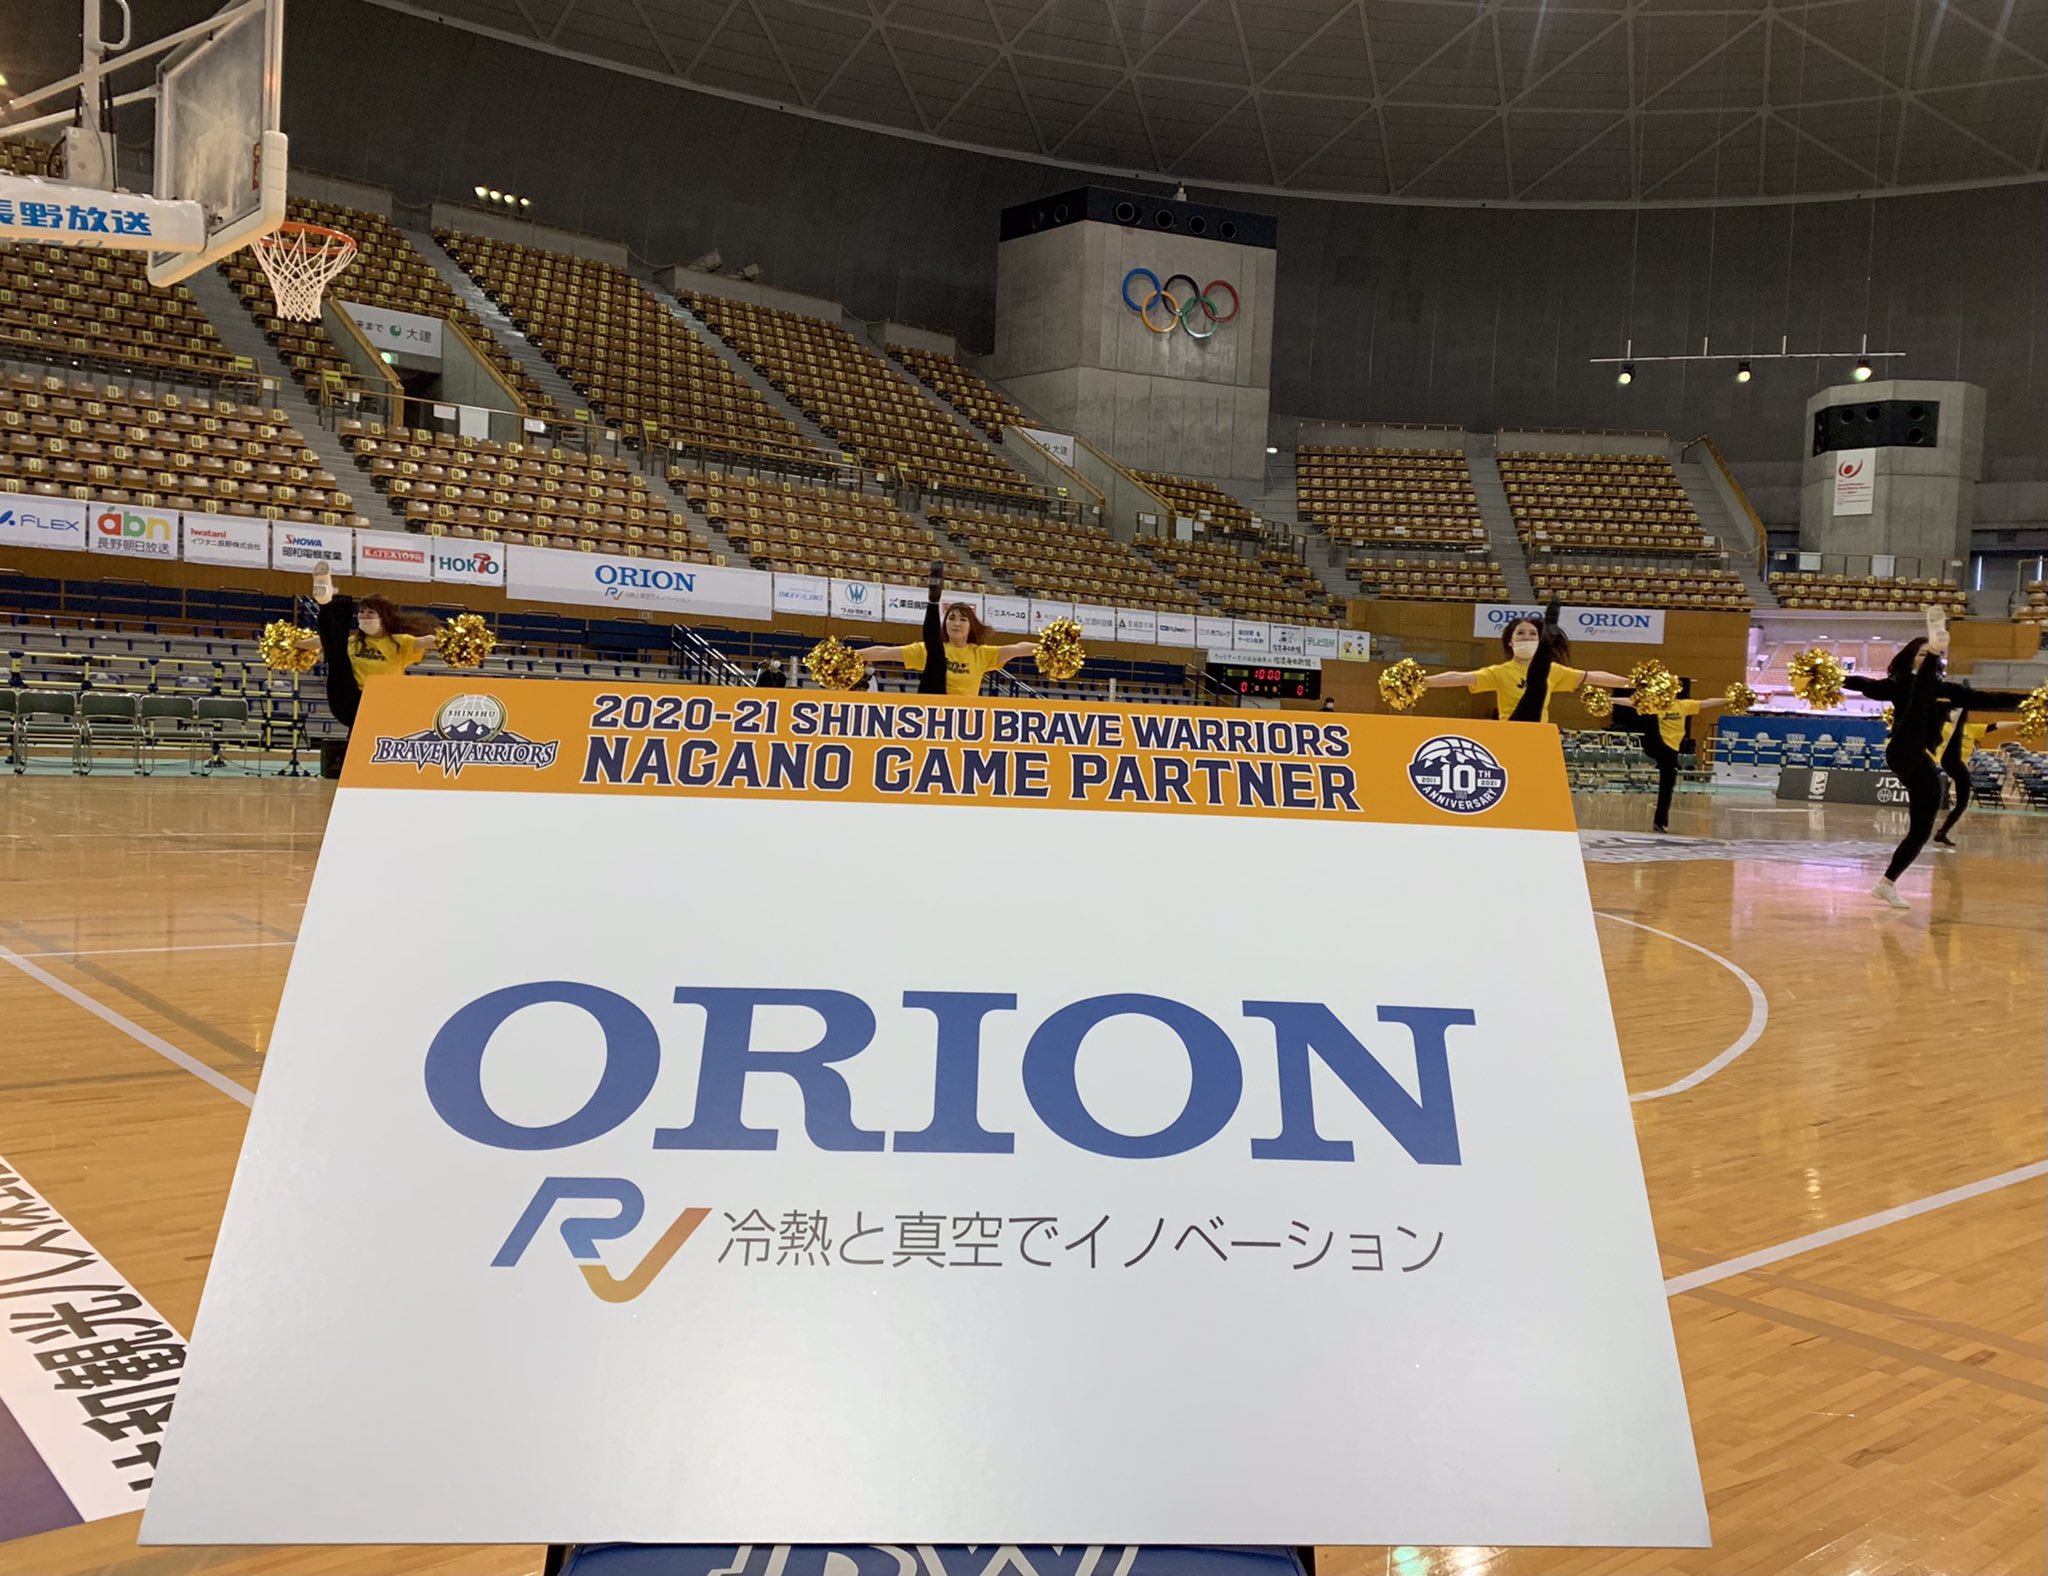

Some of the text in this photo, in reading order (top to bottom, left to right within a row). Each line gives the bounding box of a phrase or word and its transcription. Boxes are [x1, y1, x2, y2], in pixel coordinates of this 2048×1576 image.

[406, 328, 432, 343] 大建
[21, 514, 79, 531] FLEX
[97, 509, 171, 541] abn
[191, 528, 226, 538] Iwatani
[285, 534, 323, 548] SHOWA
[97, 537, 170, 555] 長野朝日放送
[439, 553, 499, 575] HOKTO
[595, 565, 696, 592] ORION
[1488, 610, 1547, 623] ORIO
[1578, 613, 1651, 628] ORION
[447, 709, 496, 718] SHINSHU
[590, 694, 1350, 758] 2020-21 SHINSHU BRAVE WARRIORS
[580, 735, 1364, 812] NAGANO GAME PARTNER
[1421, 785, 1497, 810] ANNIVERSARY
[424, 981, 1476, 1166] ORION
[490, 1177, 1445, 1302] RV 冷熱と真空でイノベーション
